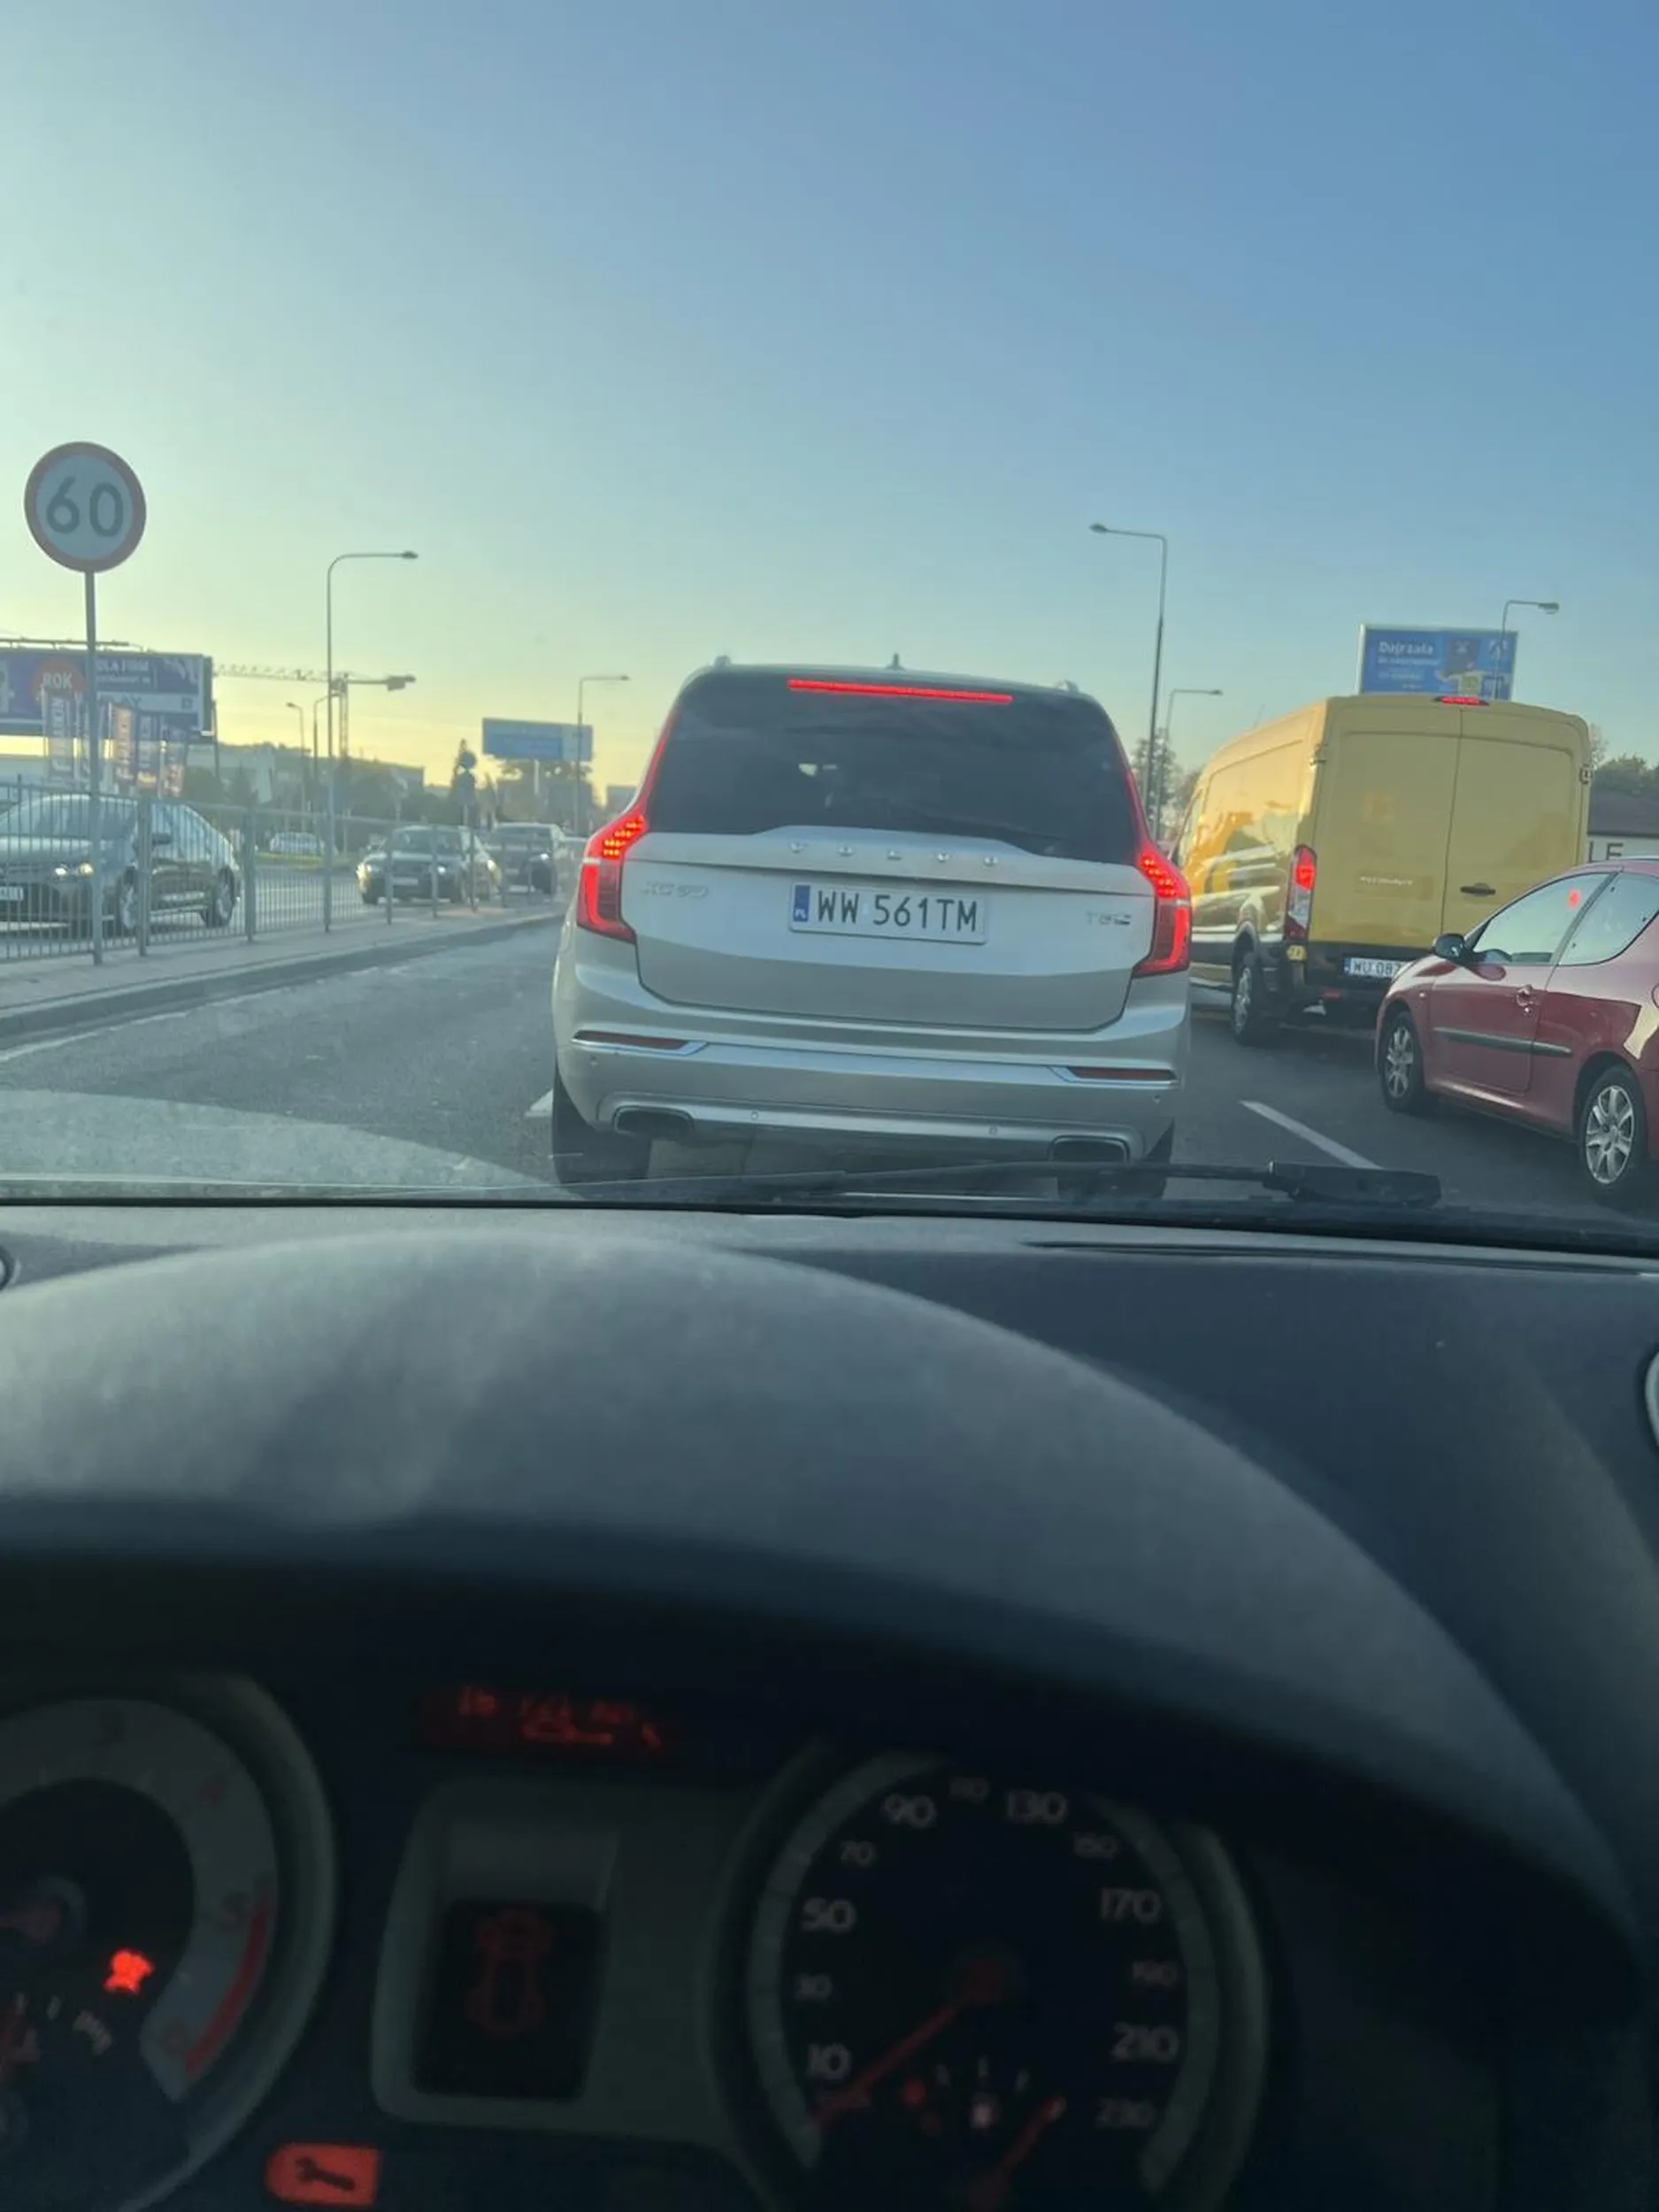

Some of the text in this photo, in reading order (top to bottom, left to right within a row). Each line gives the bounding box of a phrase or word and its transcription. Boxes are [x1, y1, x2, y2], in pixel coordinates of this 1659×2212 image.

[46, 476, 124, 538] 60
[818, 890, 977, 933] WW 561TM
